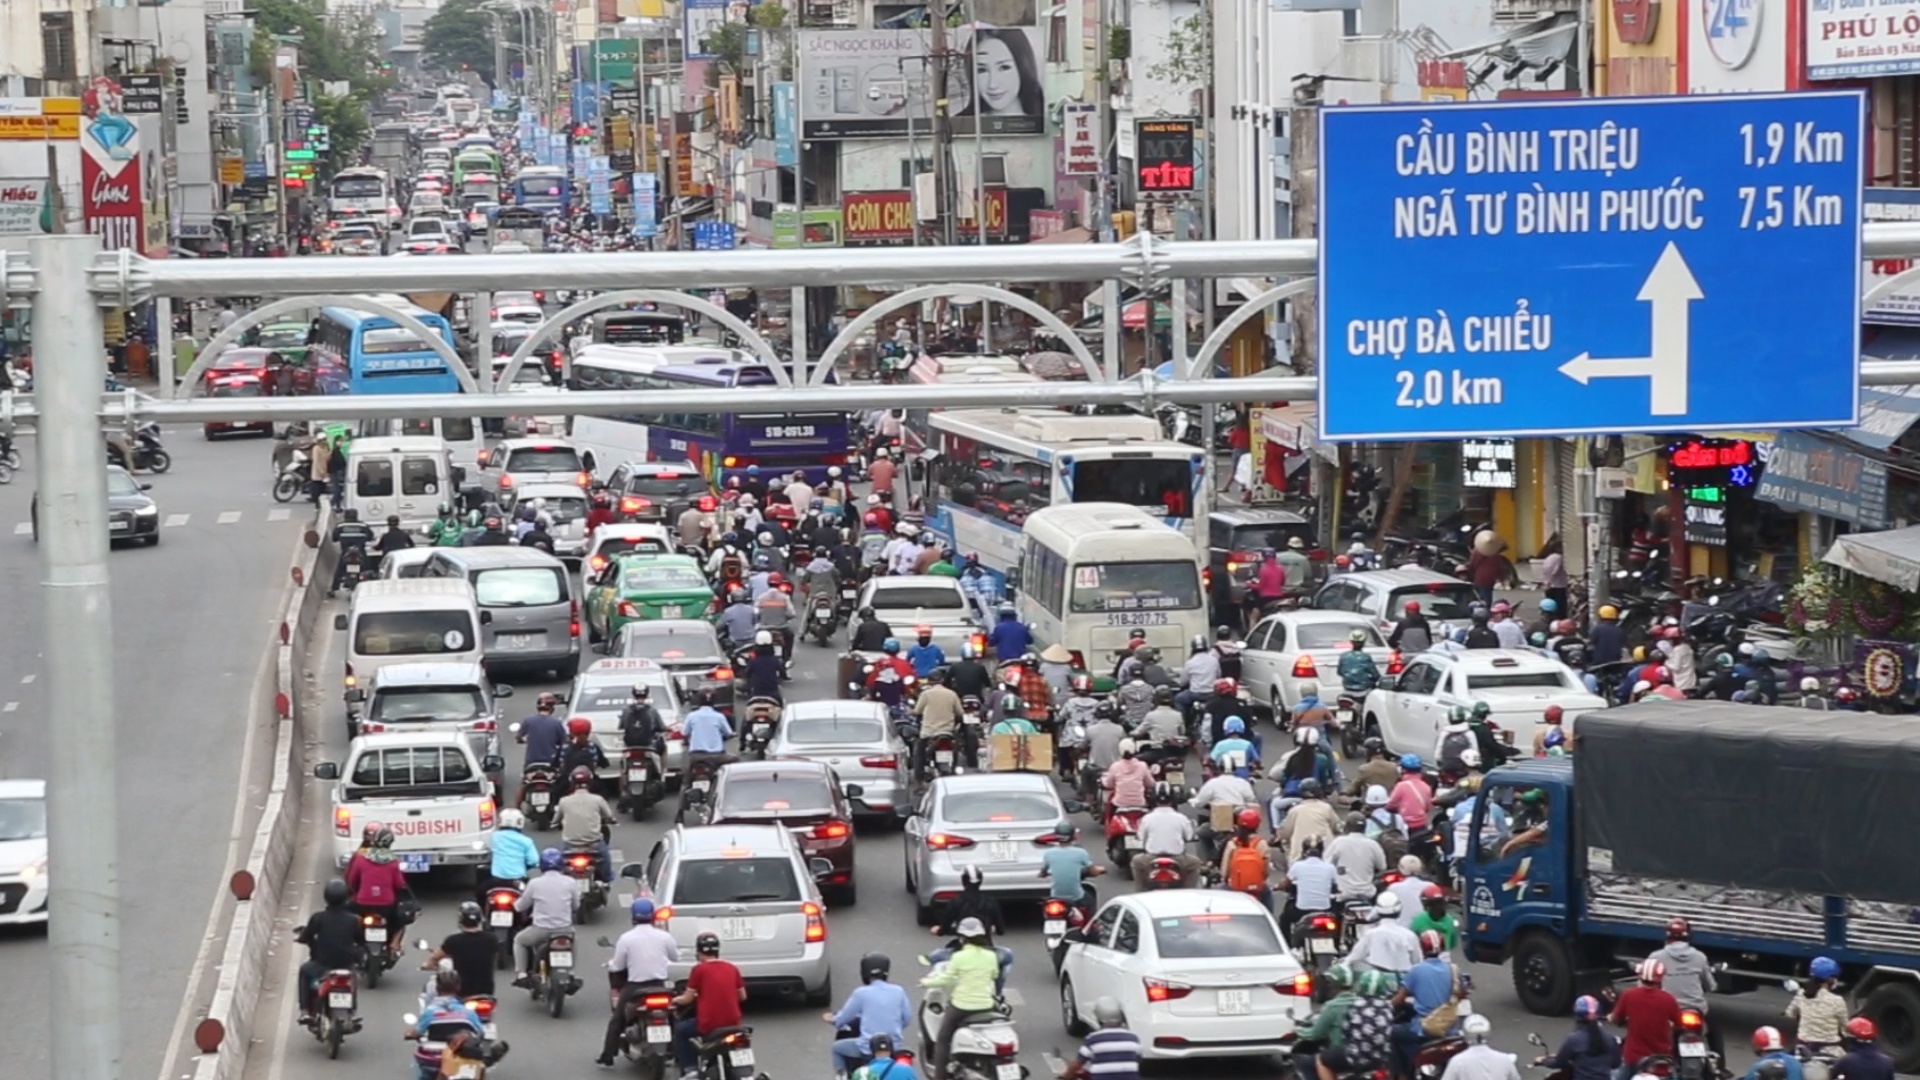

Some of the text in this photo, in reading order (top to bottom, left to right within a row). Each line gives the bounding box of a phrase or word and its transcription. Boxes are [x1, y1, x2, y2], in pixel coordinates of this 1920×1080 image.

[1821, 12, 1877, 41] PHÚ
[809, 37, 913, 53] SẮC NGỌC KHANG
[175, 67, 190, 124] Benelli
[1395, 118, 1845, 177] CẦU BÌNH TRIỆU 1,9 Km
[1141, 160, 1193, 188] TÍN
[2, 184, 38, 201] Hiếu
[1394, 177, 1843, 238] NGÃ TƯ BÌNH PHƯỚC 7,5 Km
[848, 199, 880, 231] CƠM
[1347, 298, 1552, 360] CHỢ BÀ CHIỂU
[1396, 369, 1502, 408] 2,0 km
[1077, 568, 1097, 586] 44
